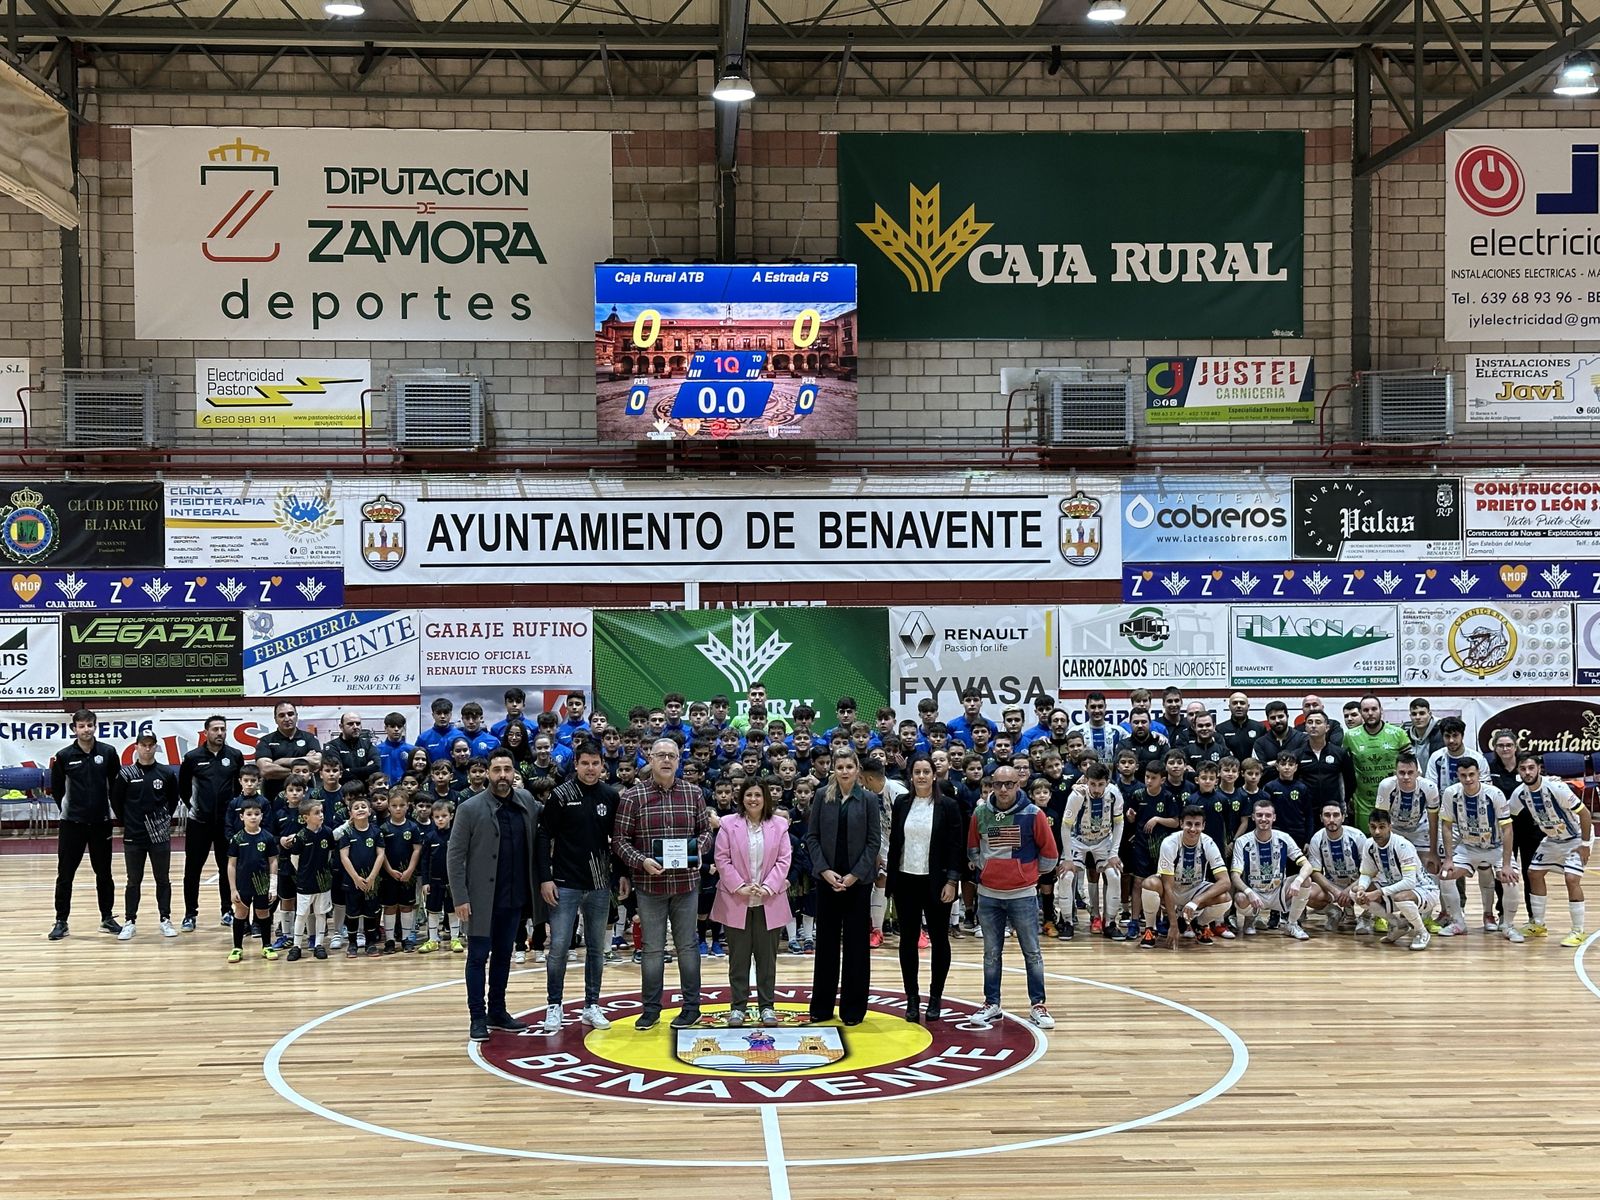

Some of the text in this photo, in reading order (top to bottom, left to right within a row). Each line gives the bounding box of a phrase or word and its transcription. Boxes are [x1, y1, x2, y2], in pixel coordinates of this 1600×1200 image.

[308, 220, 548, 265] ZAMORA
[967, 242, 1288, 288] CAJA RURAL
[1451, 269, 1577, 279] INSTALACIONES ELECTRICAS
[615, 273, 705, 285] Caja Rural ATB
[752, 273, 829, 283] A Estrada FS
[221, 278, 532, 330] deportes
[1452, 292, 1572, 304] Tel. 639 68 93 96
[632, 309, 662, 349] 0
[792, 309, 821, 348] 0
[714, 357, 740, 374] 1Q
[1476, 358, 1571, 368] INSTALACIONES
[208, 368, 284, 382] Electricidad
[1198, 361, 1302, 385] JUSTEL
[1476, 369, 1548, 378] ELÉCTRICAS
[208, 383, 253, 396] Pastor
[1496, 380, 1565, 401] Javi
[630, 390, 646, 410] 0
[699, 387, 746, 414] 0.0
[800, 390, 814, 409] 0
[170, 486, 222, 495] CLÍNICA
[1157, 493, 1281, 505] LACTEAS
[68, 500, 158, 511] CLUB DE TIRO
[170, 498, 265, 506] FISIOTERAPIA
[1477, 496, 1586, 511] PRIETO LEÓN
[170, 509, 240, 517] INTEGRAL
[1157, 504, 1288, 529] cobreros
[1304, 482, 1372, 552] RESTAURANTE
[85, 519, 146, 531] EL JARAL
[427, 510, 1043, 552] AYUNTAMIENTO DE BENAVENTE
[1340, 508, 1415, 539] Palas
[1157, 534, 1288, 543] www.lacteascobreros.com
[1548, 530, 1593, 538] Explotaciones
[1201, 575, 1212, 596] Z
[1273, 575, 1284, 595] Z
[1343, 574, 1355, 595] Z
[1415, 574, 1426, 595] Z
[1501, 571, 1527, 582] AMOR
[13, 581, 41, 591] AMOR
[110, 582, 122, 603] Z
[185, 582, 197, 603] Z
[259, 581, 272, 602] Z
[1131, 576, 1143, 597] Z
[1531, 590, 1580, 598] CAJA RURAL
[70, 618, 237, 649] VEGAPAL
[253, 612, 360, 662] FERRETERIA
[426, 623, 588, 640] GARAJE RUFINO
[944, 629, 1029, 640] RENAULT
[259, 616, 416, 694] LA FUENTE
[427, 651, 531, 661] SERVICIO OFICIAL
[944, 644, 1008, 652] Passion for life
[427, 664, 573, 676] RENAULT TRUCKS ESPAÑA
[1063, 659, 1226, 678] CARROZADOS DEL NOROESTE
[332, 675, 349, 683] Tel.
[354, 675, 370, 683] 980
[389, 674, 400, 682] 06
[405, 674, 415, 682] 34
[16, 687, 35, 695] 416
[899, 676, 1046, 705] FYVASA
[507, 1045, 1014, 1098] BENAVENTE
